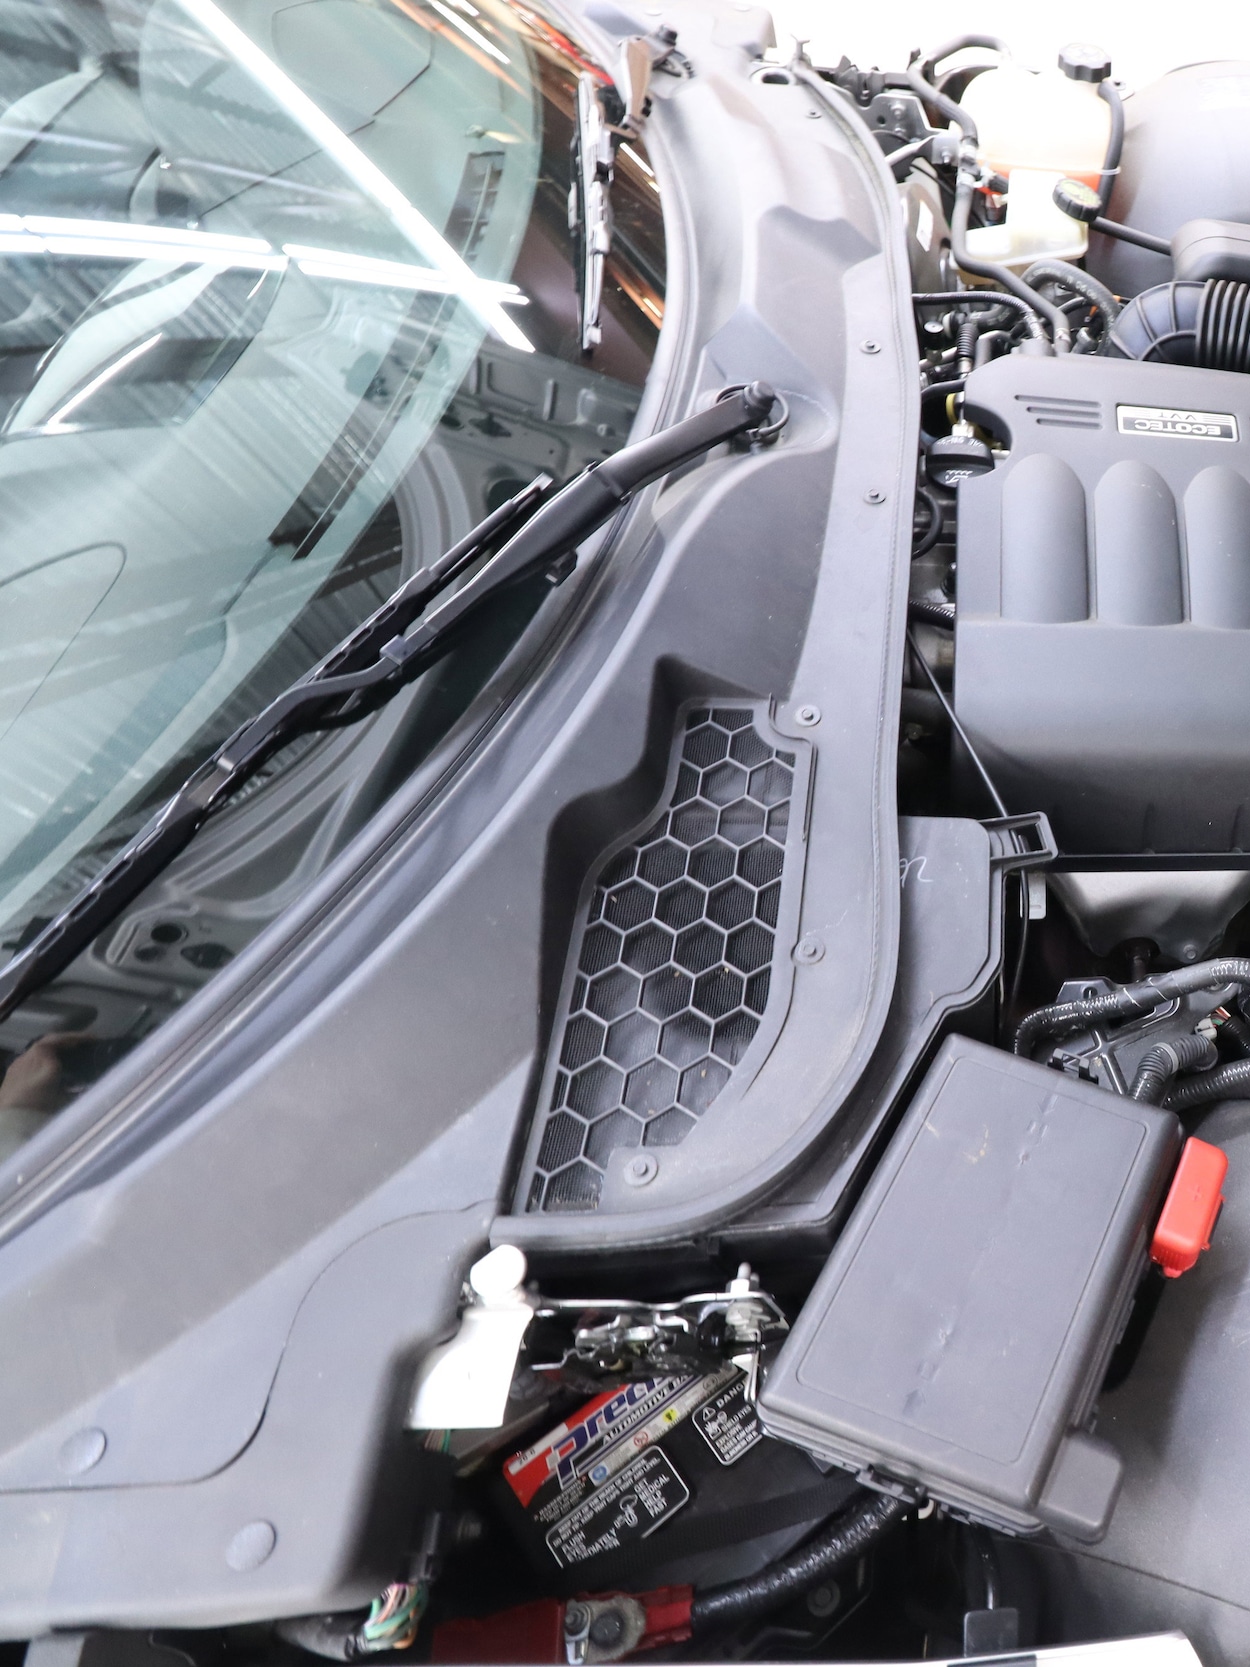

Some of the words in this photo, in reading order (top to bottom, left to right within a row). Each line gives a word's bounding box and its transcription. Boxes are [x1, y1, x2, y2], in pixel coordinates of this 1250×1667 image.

[1157, 411, 1196, 420] VVT
[1133, 419, 1221, 436] ECOTEC
[601, 1387, 669, 1444] AUTOMOTIVE
[633, 1477, 649, 1493] GET
[638, 1472, 670, 1501] MEDICAL
[643, 1489, 664, 1509] HELP
[648, 1497, 669, 1518] FAST
[560, 1530, 587, 1554] FLUSH
